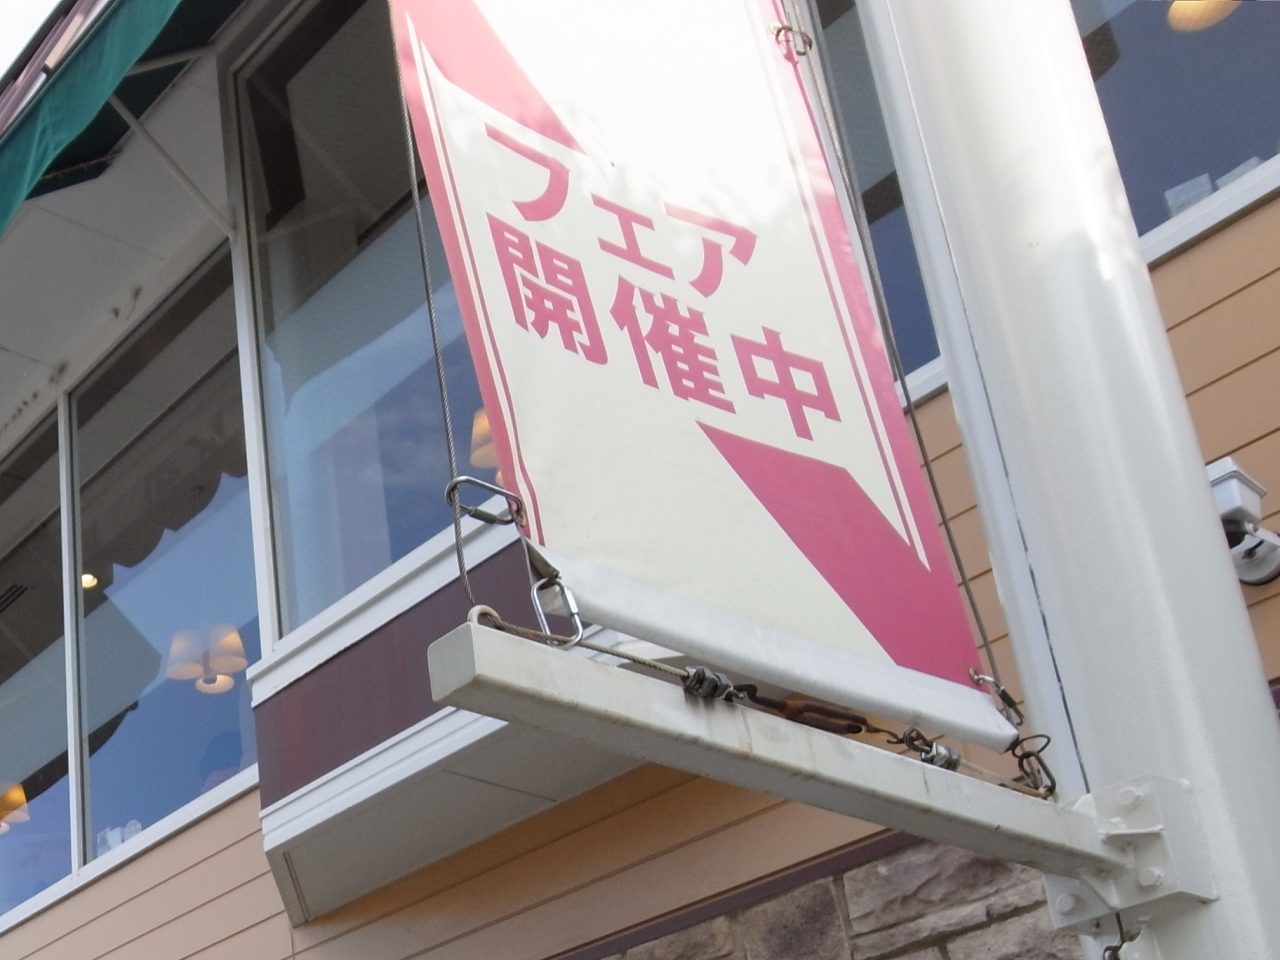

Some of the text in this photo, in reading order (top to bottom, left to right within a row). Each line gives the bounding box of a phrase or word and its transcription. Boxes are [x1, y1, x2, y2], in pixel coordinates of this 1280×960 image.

[483, 122, 758, 297] フェア
[486, 212, 841, 442] 開催中
